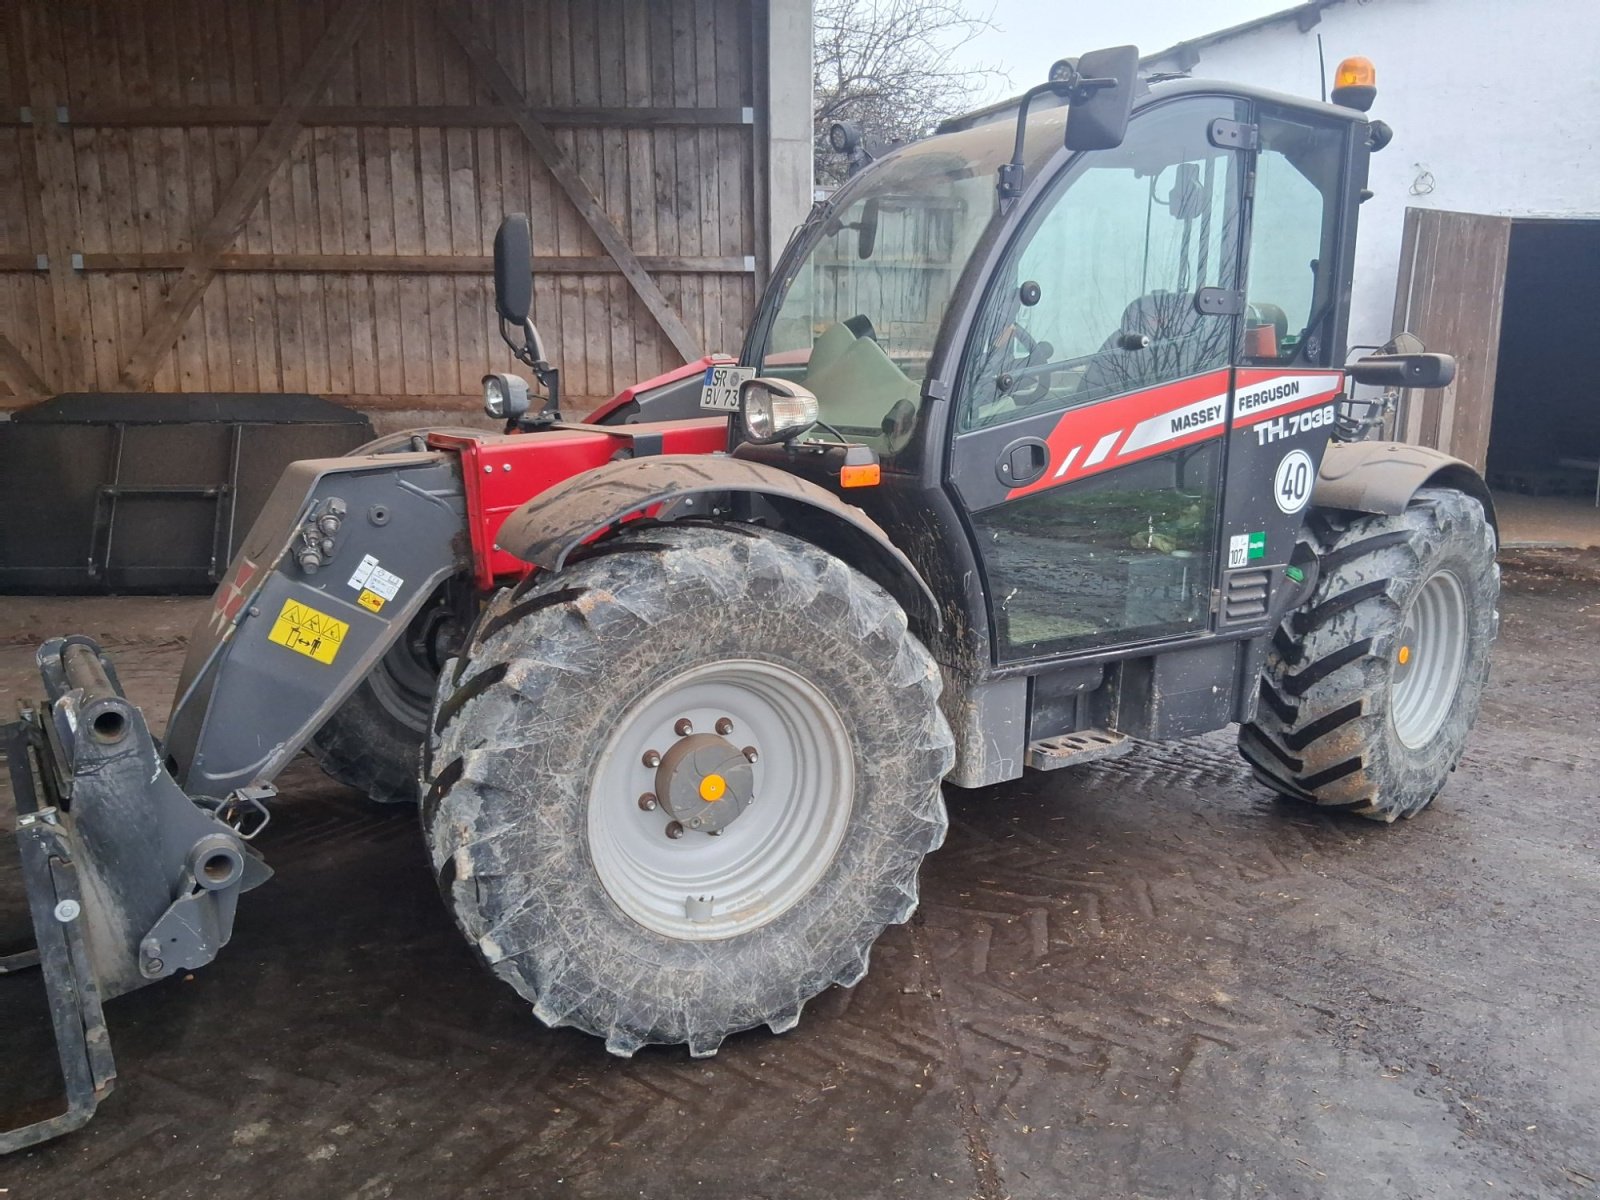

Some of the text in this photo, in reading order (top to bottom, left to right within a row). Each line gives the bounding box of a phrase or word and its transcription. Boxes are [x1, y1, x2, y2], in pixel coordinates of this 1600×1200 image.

[705, 388, 740, 406] BV 73
[713, 370, 727, 387] SR
[1171, 381, 1299, 432] MASSEY FERGUSON
[1254, 406, 1334, 445] TH.7038
[1281, 462, 1307, 500] 40
